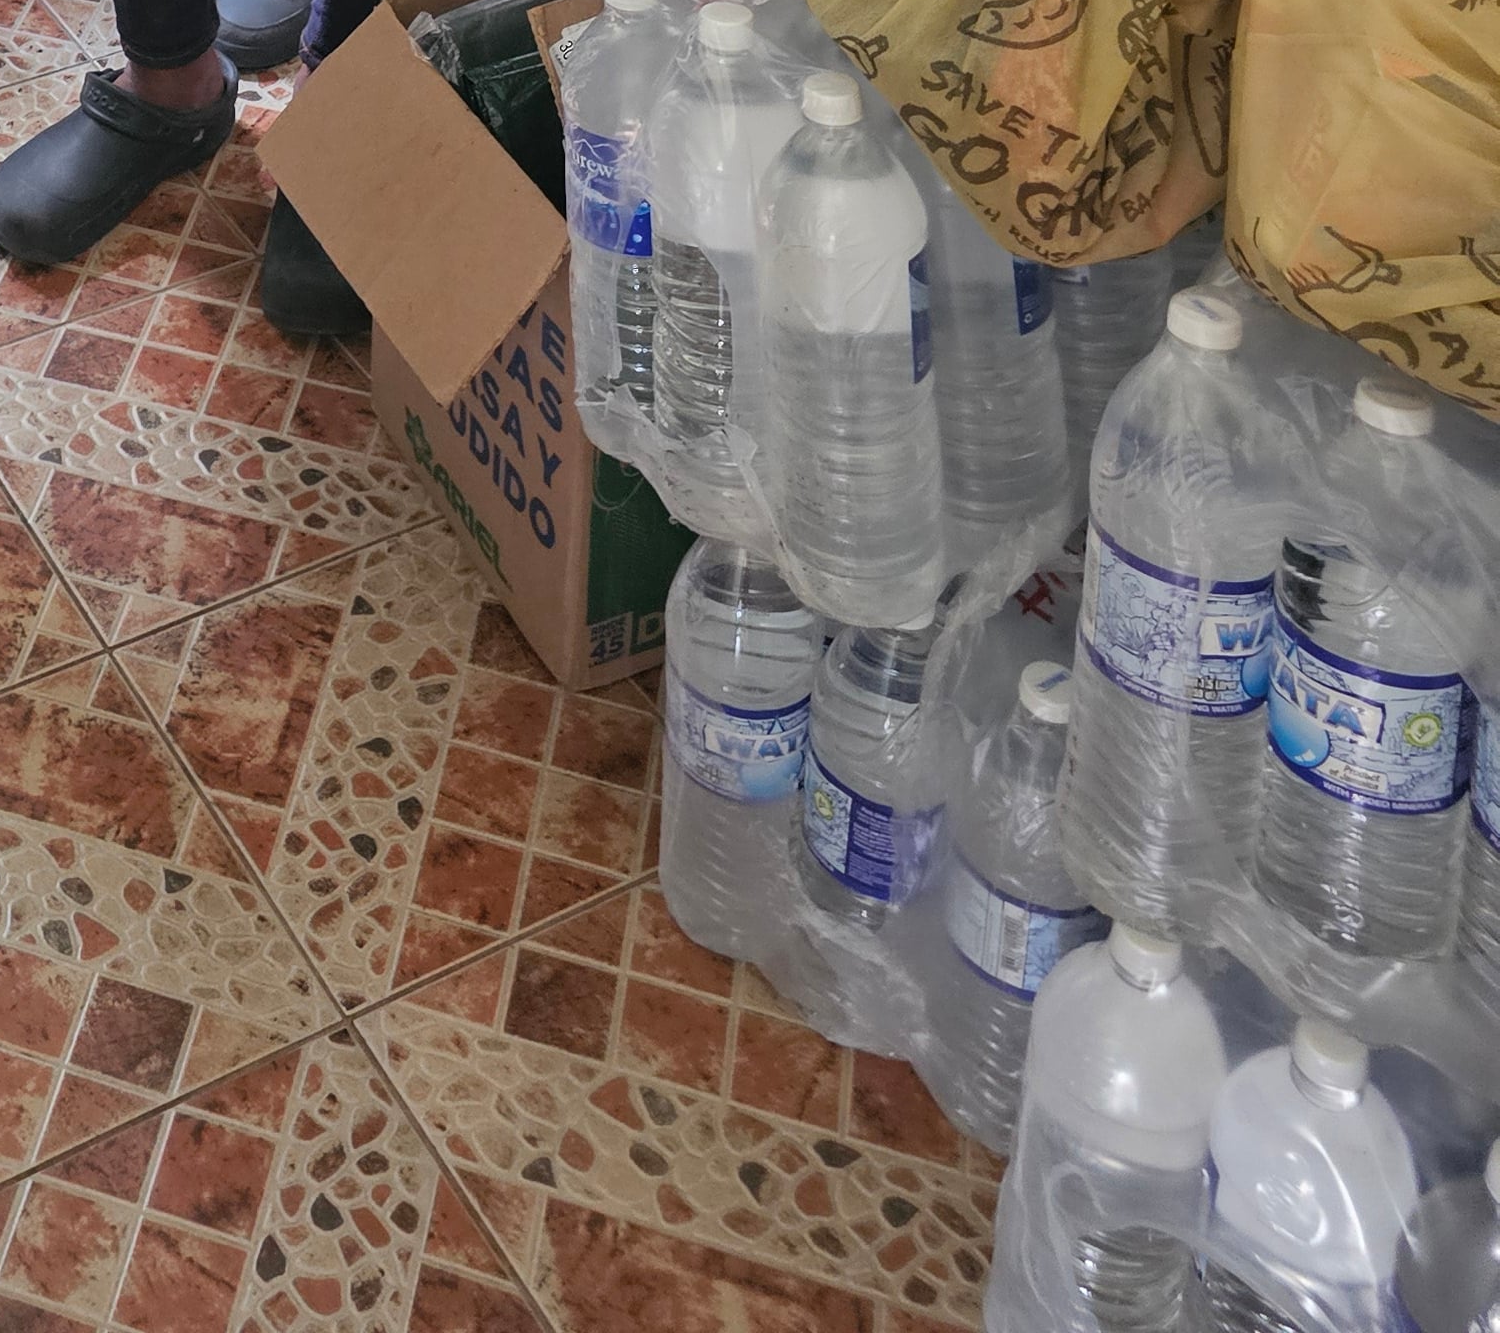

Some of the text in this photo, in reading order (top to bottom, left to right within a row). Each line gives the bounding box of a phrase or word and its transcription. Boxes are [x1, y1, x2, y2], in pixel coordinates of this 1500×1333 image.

[899, 102, 1010, 185] GO
[920, 60, 1098, 174] SAVE TH
[448, 399, 557, 550] UDIDO
[1270, 658, 1369, 739] ATA
